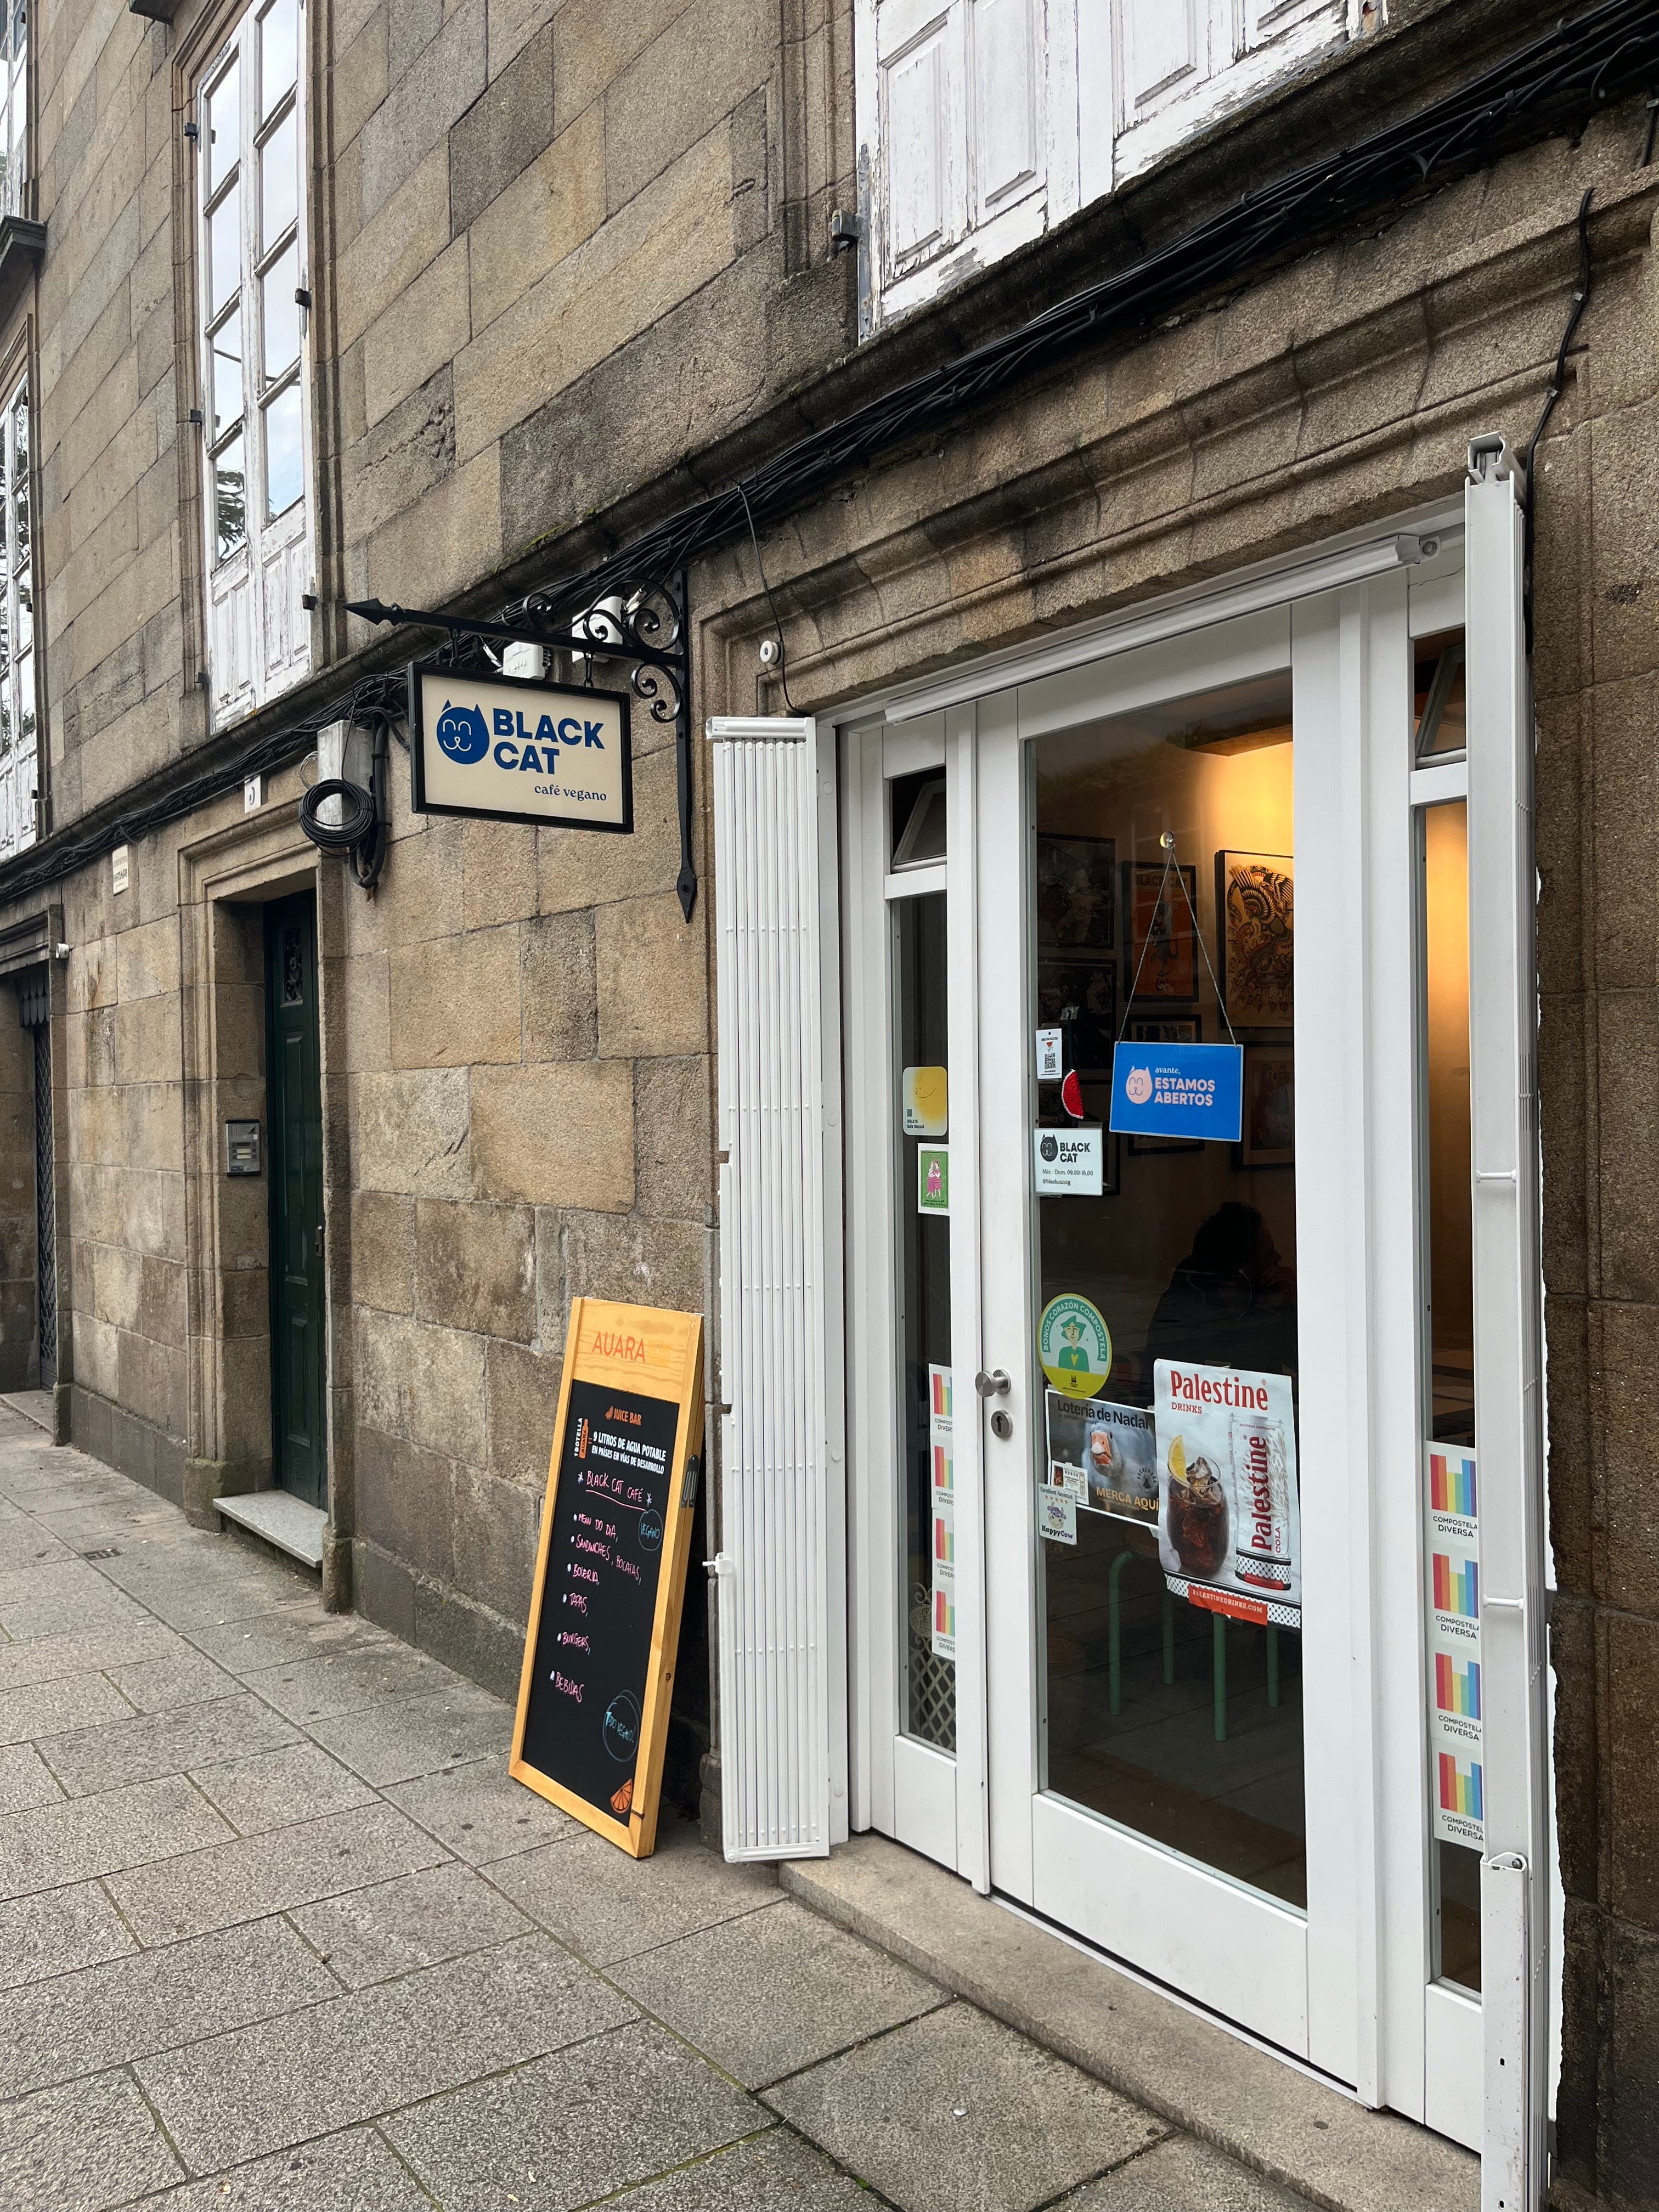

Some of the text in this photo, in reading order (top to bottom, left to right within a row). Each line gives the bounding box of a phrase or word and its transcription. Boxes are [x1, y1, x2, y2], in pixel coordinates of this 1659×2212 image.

[493, 708, 605, 749] BLACK
[494, 742, 560, 775] CAT
[534, 785, 607, 801] café vegano
[1155, 1077, 1215, 1092] ESTAMOS
[1154, 1091, 1213, 1107] ABERTOS
[1060, 1143, 1091, 1152] BLACK
[1060, 1153, 1078, 1163] CAT
[1043, 1301, 1106, 1359] BONOS CORAZÓN COMPOSTELA
[592, 1331, 645, 1363] AUARA
[1170, 1370, 1268, 1410] Palestine
[613, 1408, 641, 1425] JUICE BAR
[1058, 1400, 1095, 1418] Lotería
[1097, 1408, 1110, 1421] de
[1113, 1411, 1148, 1430] Nadal
[1171, 1402, 1202, 1414] DRINKS
[574, 1418, 583, 1452] BOTELLA
[593, 1431, 667, 1462] 9 LITROS DE AGUA POTABLE
[591, 1445, 664, 1475] EN PAÍSES EN VÍAS DE DESARROLLO
[586, 1470, 643, 1502] BLACK CAT CAFÉ
[1040, 1486, 1056, 1495] Excellent
[1057, 1491, 1073, 1499] Reviews
[1246, 1436, 1272, 1551] Palestine
[1096, 1486, 1132, 1504] MERCA
[1134, 1496, 1159, 1511] AQUÍ
[595, 1519, 603, 1531] DO
[641, 1522, 660, 1539] VEGANO
[1433, 1516, 1477, 1529] COMPOSTELA
[1438, 1525, 1474, 1537] DIVERSA
[1193, 1589, 1262, 1613] PALESTINEDRINKS.COM
[1441, 1624, 1476, 1639] DIVERSA
[555, 1672, 584, 1702] BEBIDAS
[1444, 1724, 1480, 1741] DIVERSA
[1442, 1815, 1483, 1833] COMPOSTEL
[1448, 1824, 1483, 1842] DIVERSA
